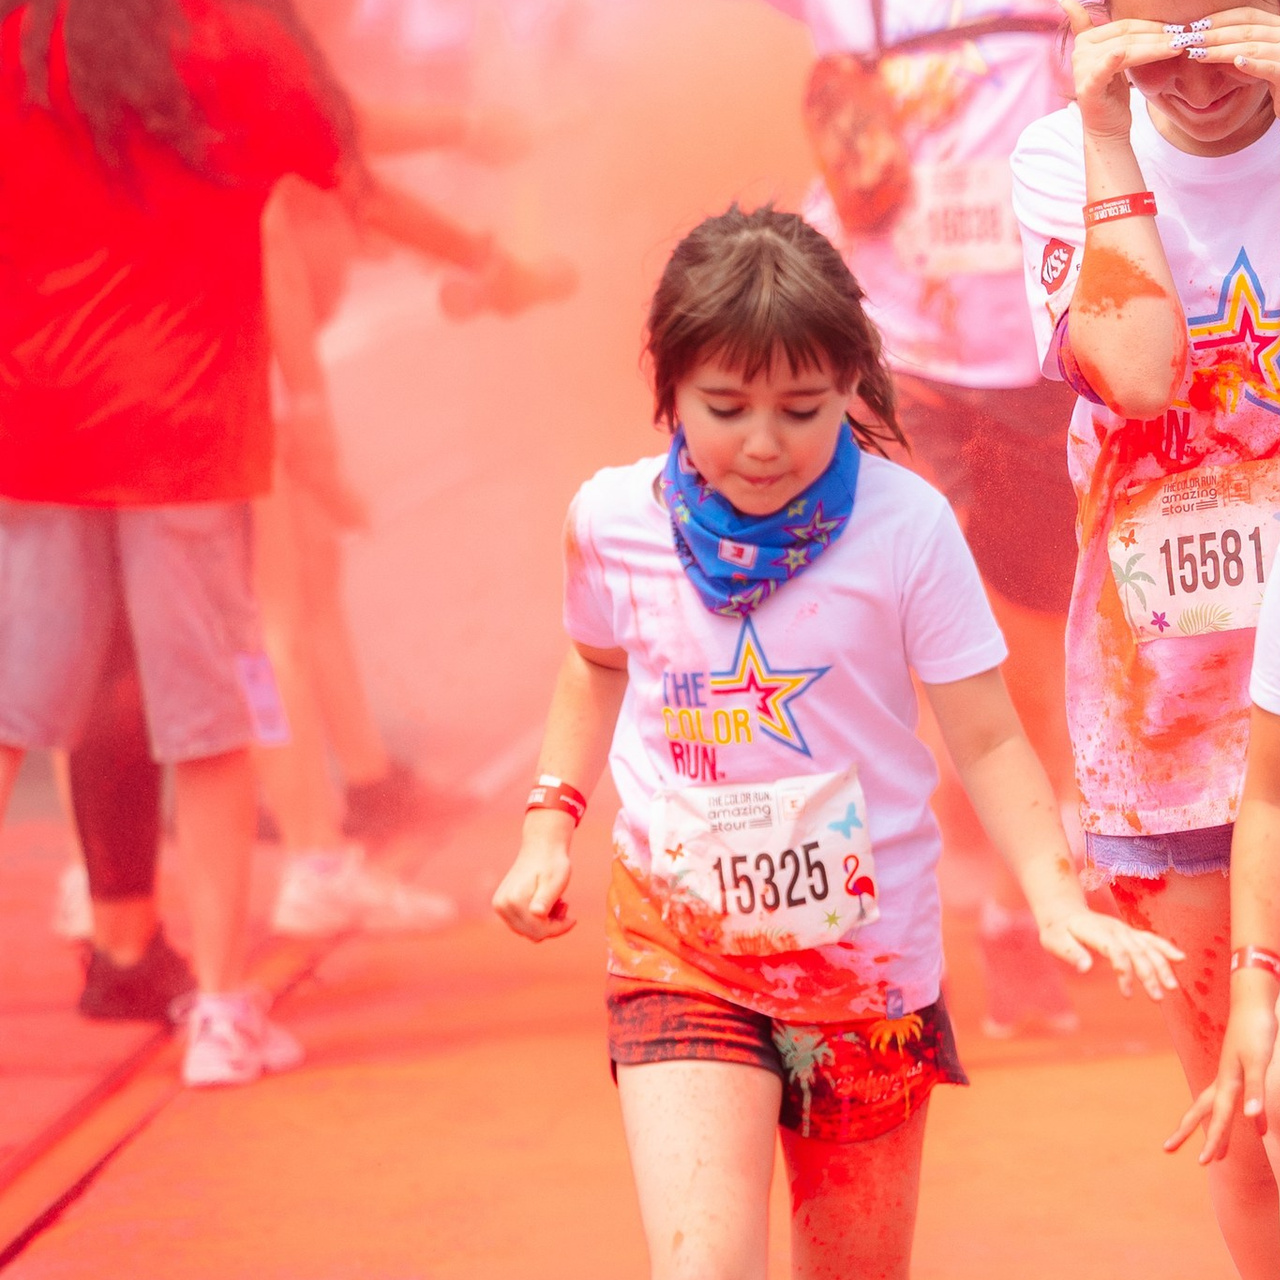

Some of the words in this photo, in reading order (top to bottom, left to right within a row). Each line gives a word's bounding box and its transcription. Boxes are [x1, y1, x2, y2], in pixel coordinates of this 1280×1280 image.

[1163, 483, 1176, 493] THE
[1176, 478, 1200, 490] COLOR
[1161, 488, 1218, 504] amazing
[1170, 503, 1195, 515] tour
[1159, 526, 1266, 596] 15581
[662, 670, 707, 708] THE
[662, 707, 753, 745] COLOR
[724, 793, 751, 805] COLOR
[708, 805, 771, 820] amazing
[718, 821, 747, 832] tour
[712, 841, 830, 916] 15325
